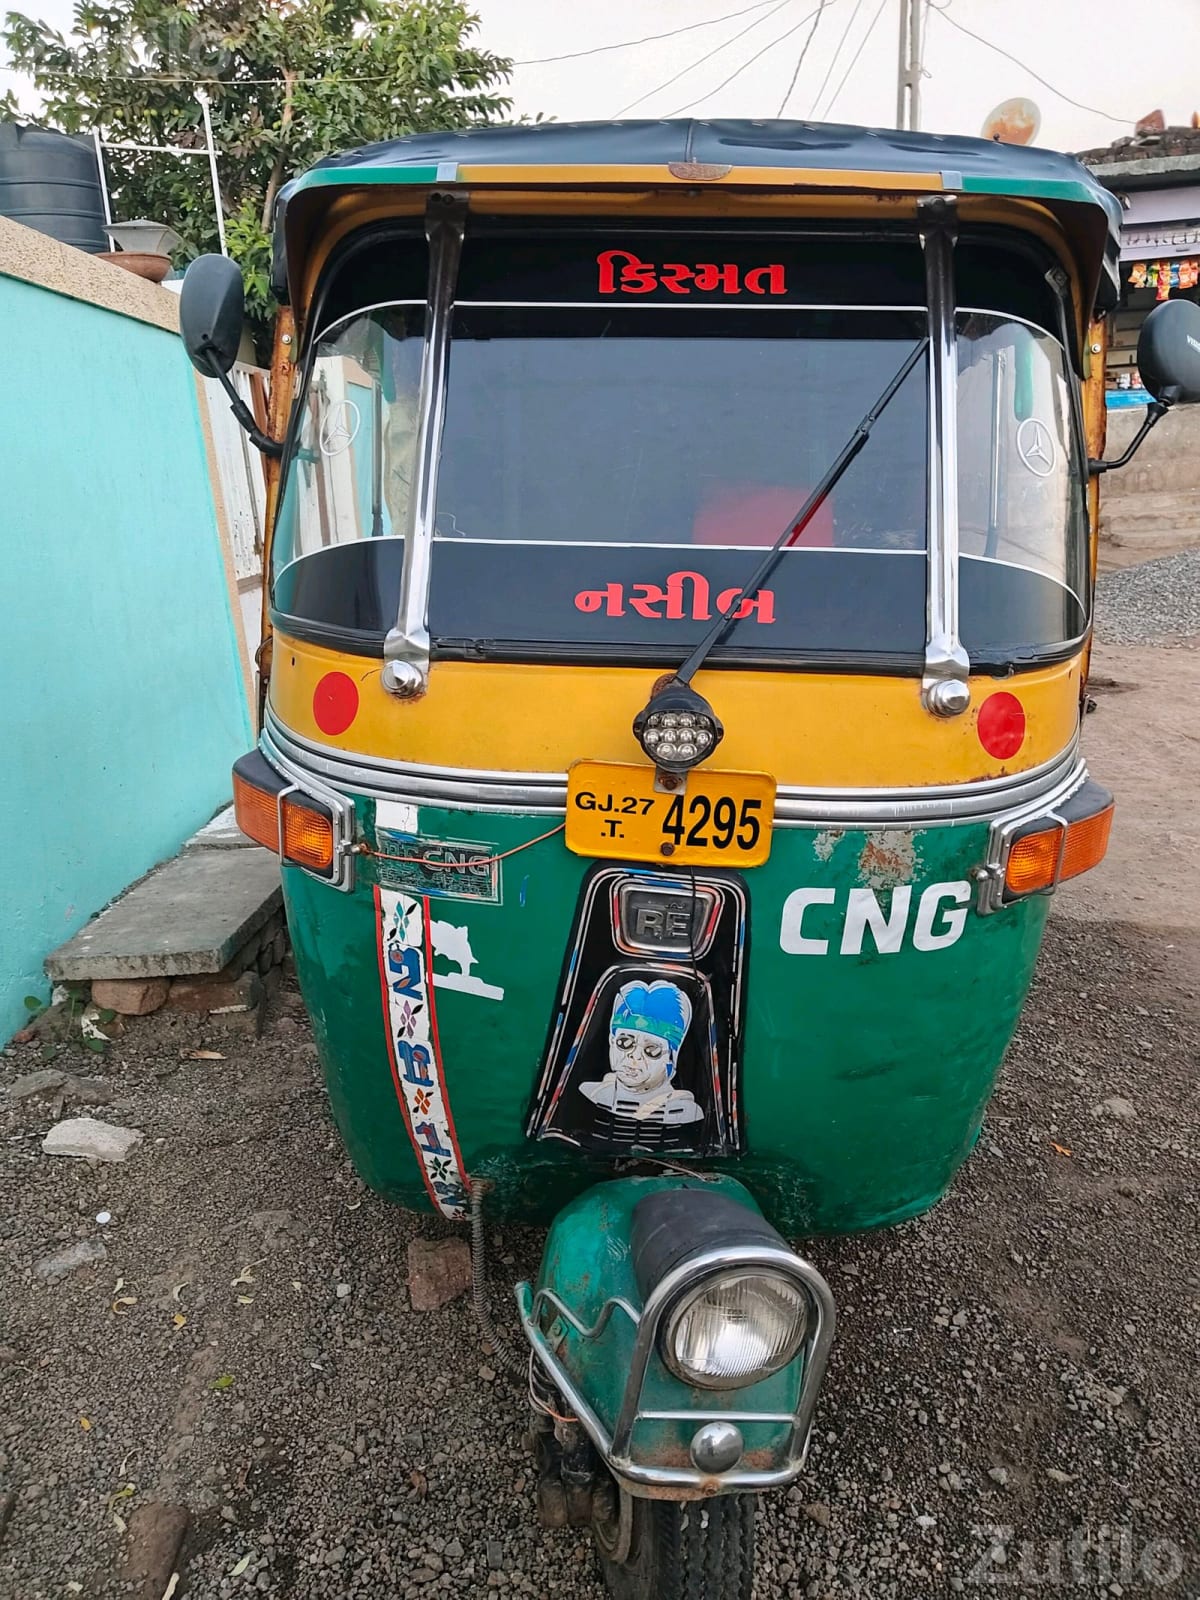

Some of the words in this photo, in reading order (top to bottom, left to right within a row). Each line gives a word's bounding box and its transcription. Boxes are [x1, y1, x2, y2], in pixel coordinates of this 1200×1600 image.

[574, 571, 776, 624] નસીબ
[575, 791, 655, 815] GJ.27
[662, 794, 761, 850] 4295
[636, 908, 691, 939] RE
[780, 880, 971, 956] CNG
